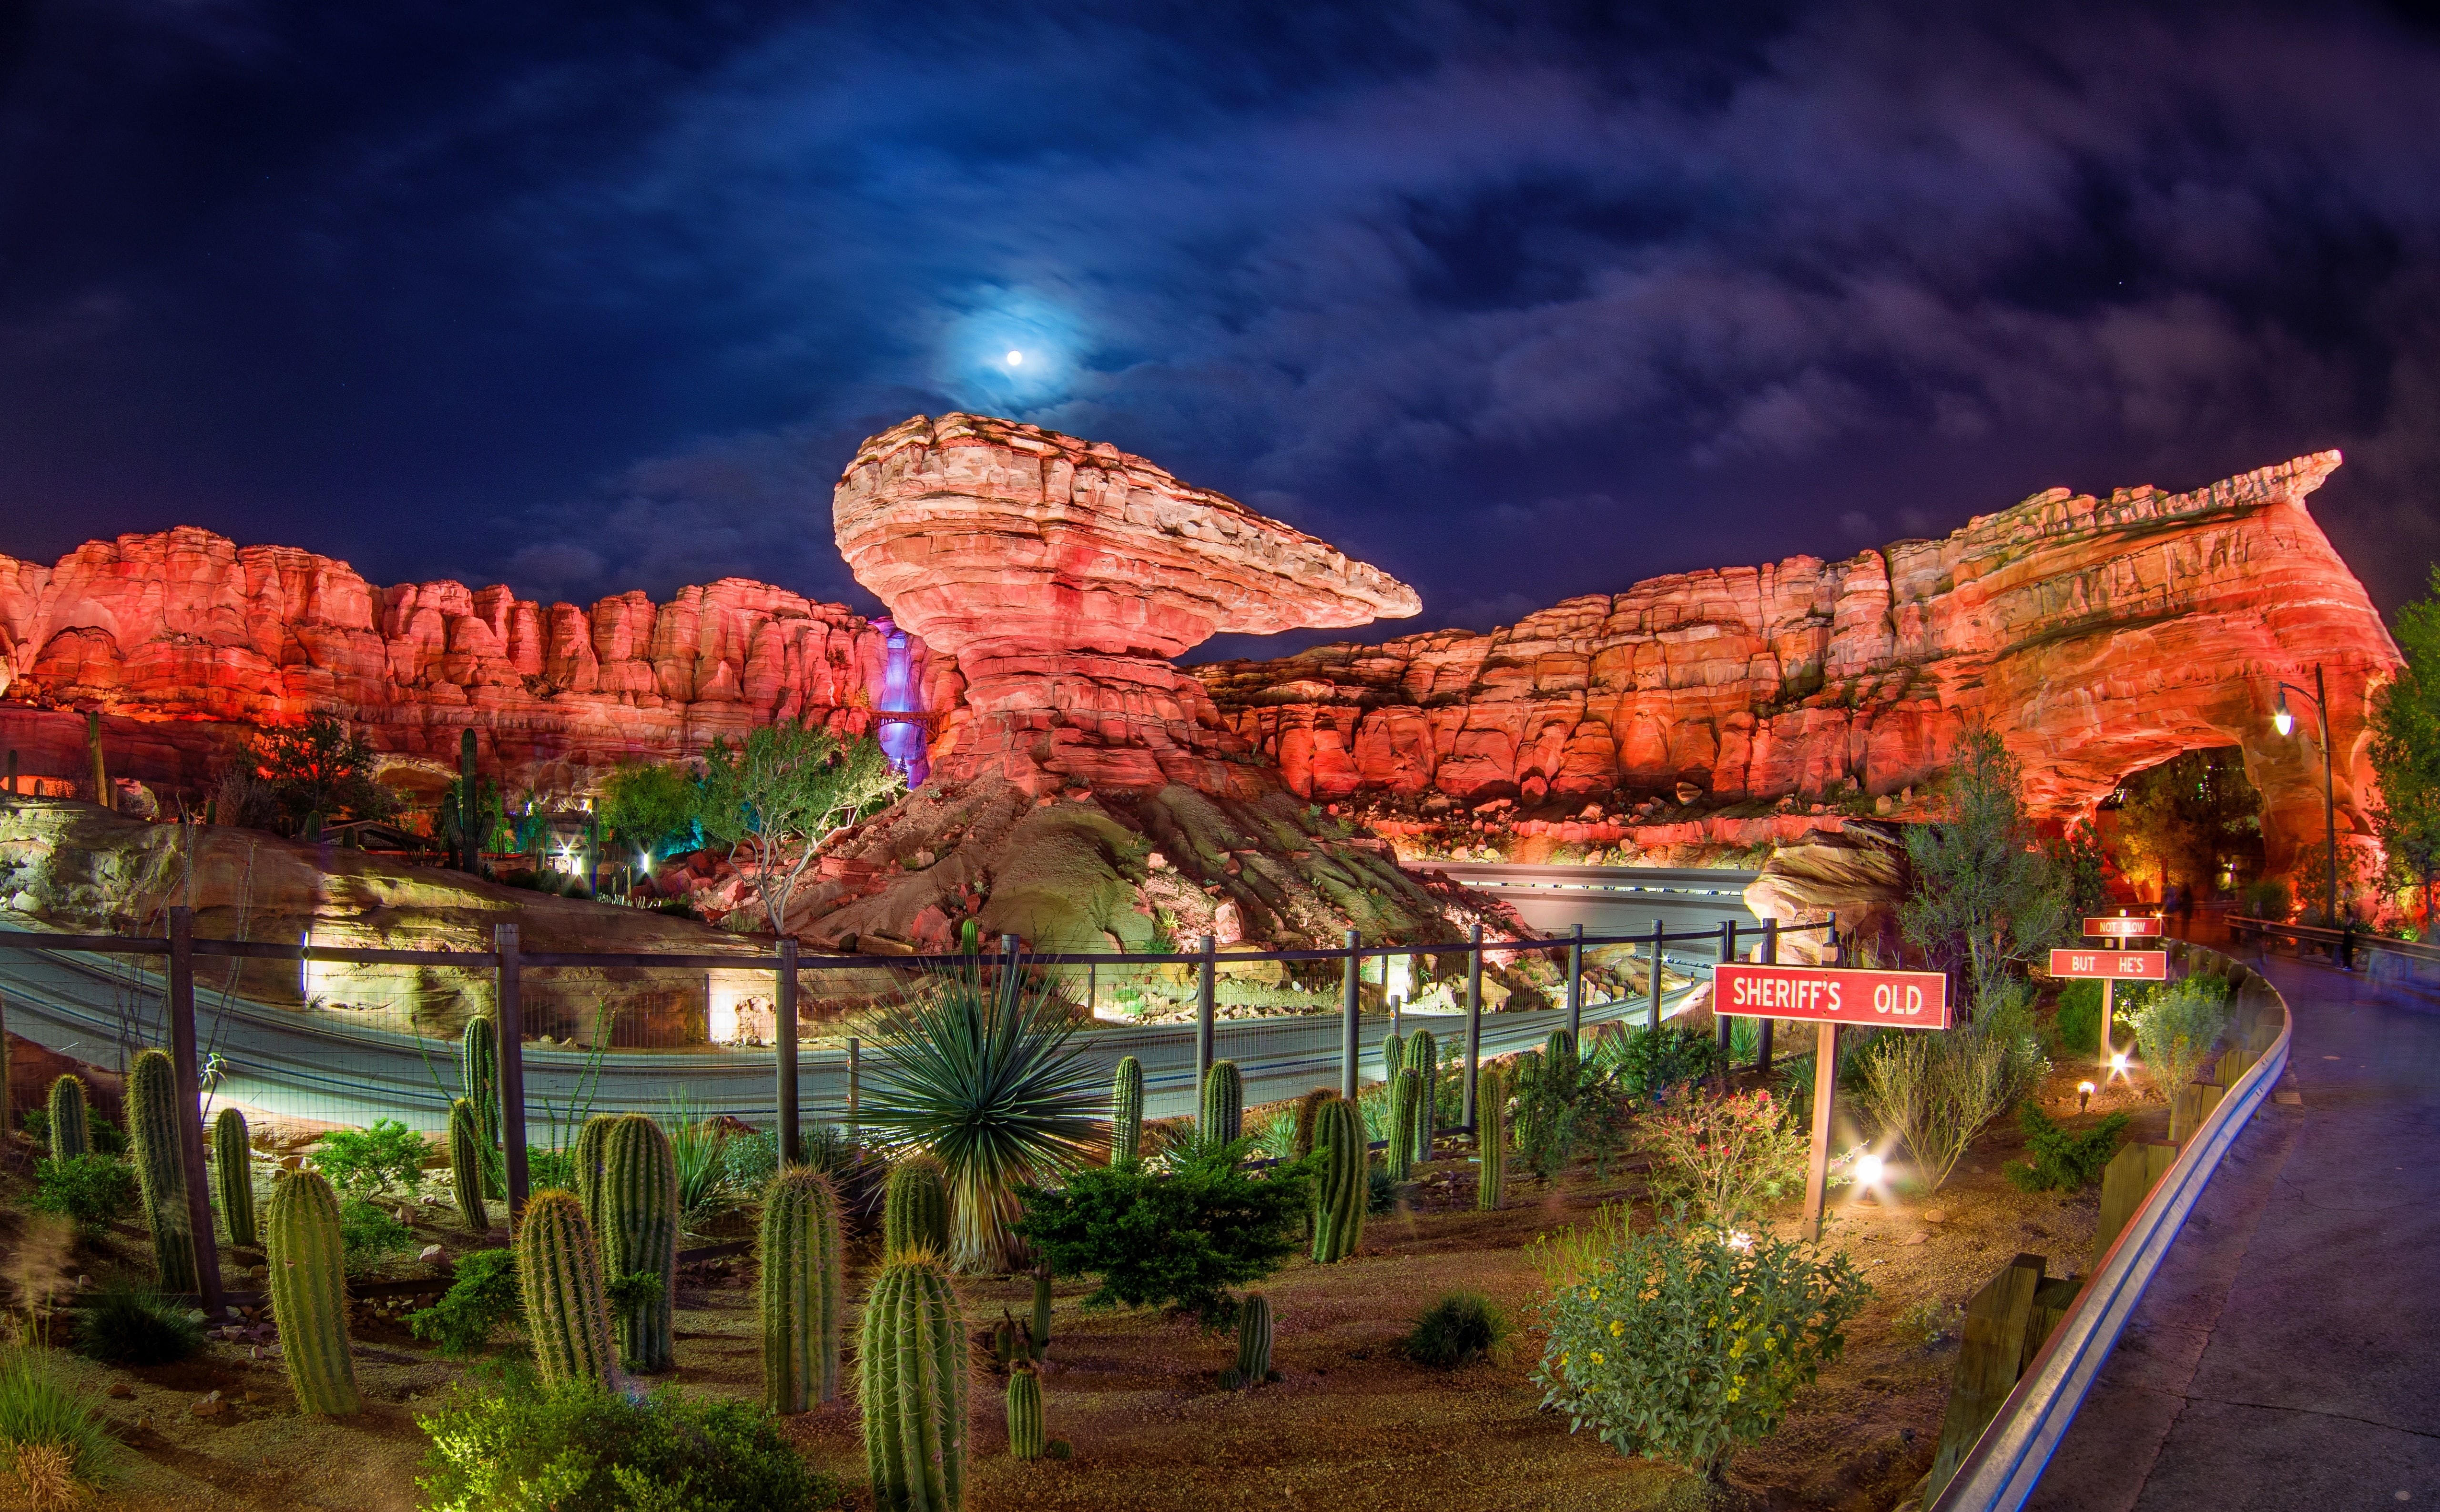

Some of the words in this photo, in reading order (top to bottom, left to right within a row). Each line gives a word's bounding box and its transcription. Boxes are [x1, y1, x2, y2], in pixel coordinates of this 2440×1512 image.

[2100, 922, 2116, 933] NOT
[2072, 956, 2095, 972] BUT
[2118, 957, 2144, 973] HE'S
[1733, 977, 1841, 1011] SHERIFF'S
[1874, 984, 1922, 1015] OLD
